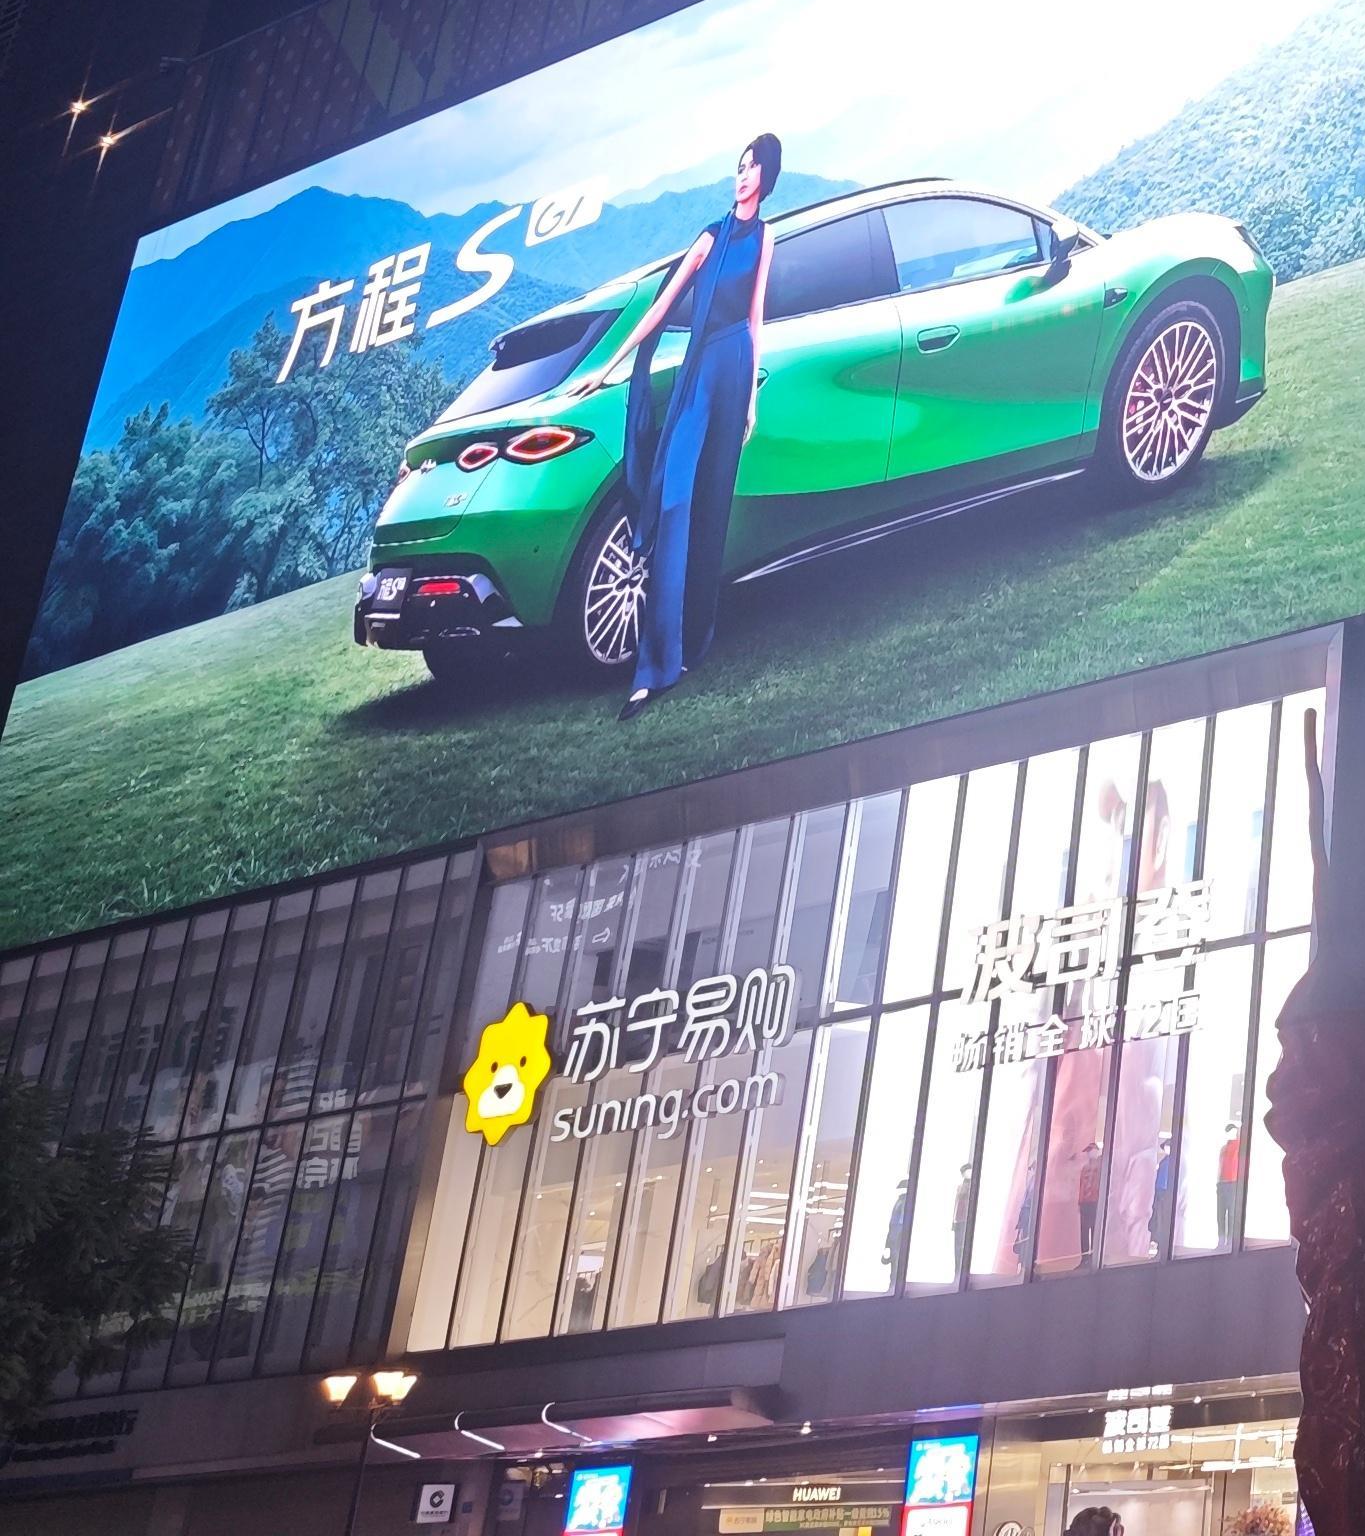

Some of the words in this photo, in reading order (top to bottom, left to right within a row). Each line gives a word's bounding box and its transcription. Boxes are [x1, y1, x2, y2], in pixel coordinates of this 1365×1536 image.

[961, 879, 1215, 1006] 波司登
[562, 964, 798, 1084] 苏宁易购
[551, 1072, 779, 1142] suning.com
[793, 1487, 841, 1501] HUAWEI
